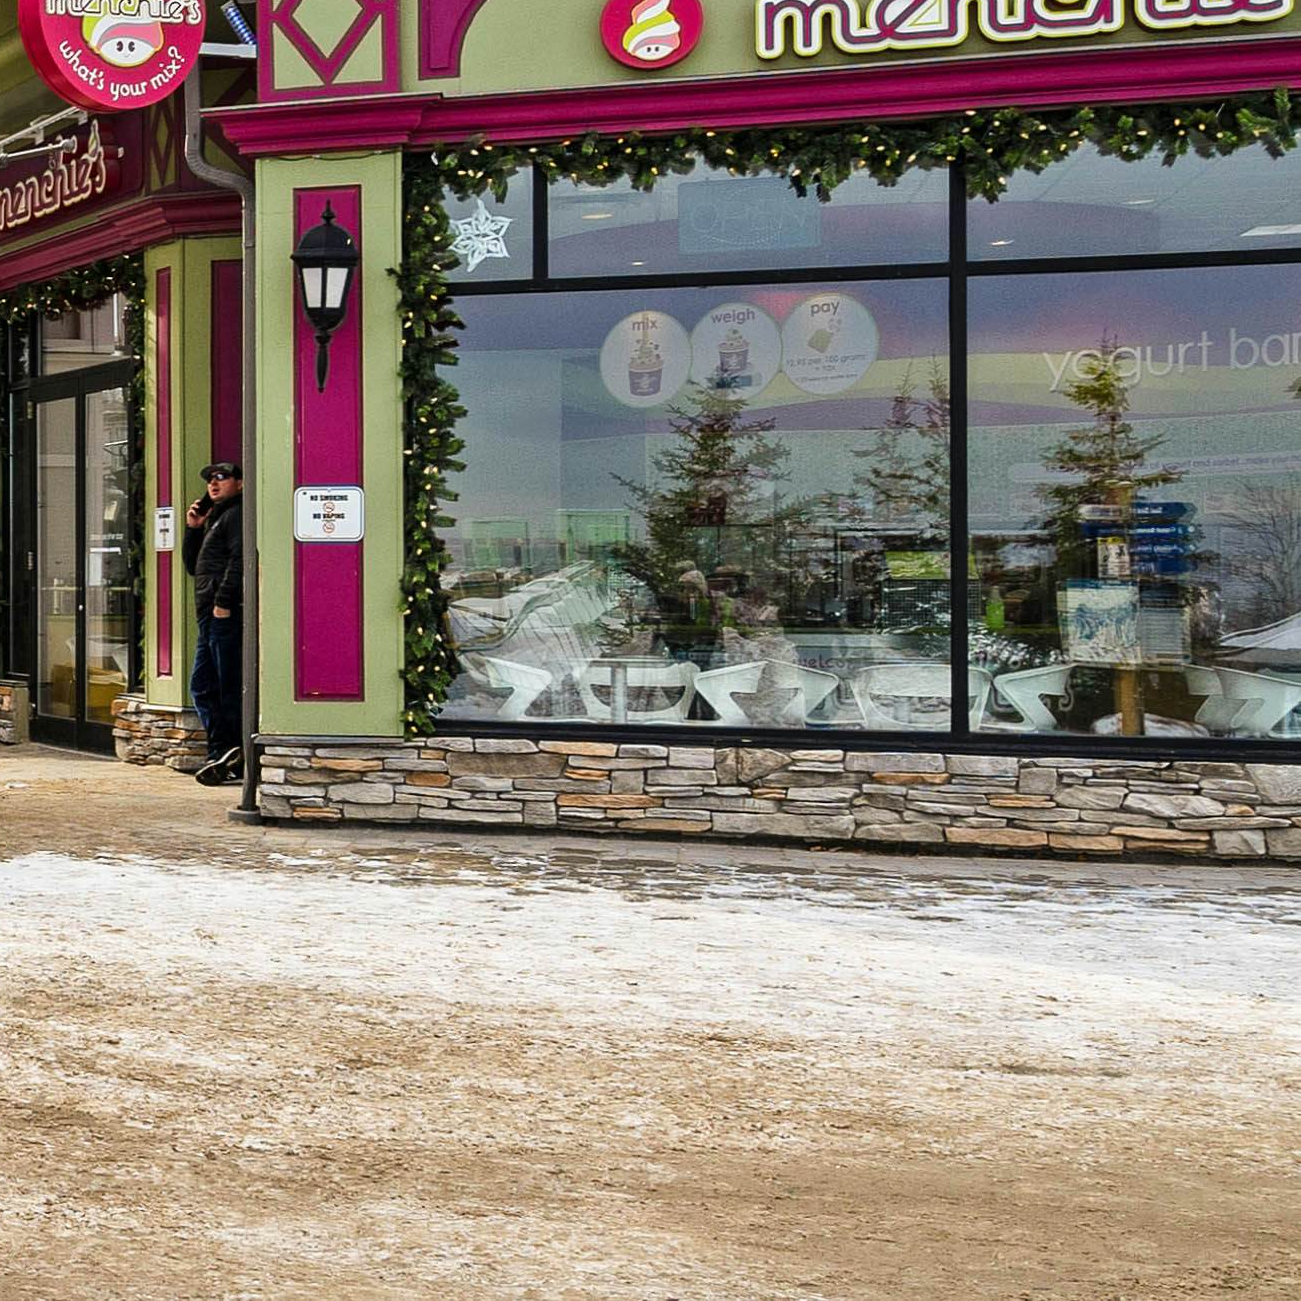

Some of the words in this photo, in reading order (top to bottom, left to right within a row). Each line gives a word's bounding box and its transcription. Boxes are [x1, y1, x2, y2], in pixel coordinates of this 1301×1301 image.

[59, 40, 104, 90] what's
[109, 79, 148, 100] your
[150, 47, 186, 90] mix?
[711, 308, 755, 324] weigh
[810, 301, 840, 316] pay
[631, 317, 658, 332] mix
[1042, 331, 1213, 393] yogurt
